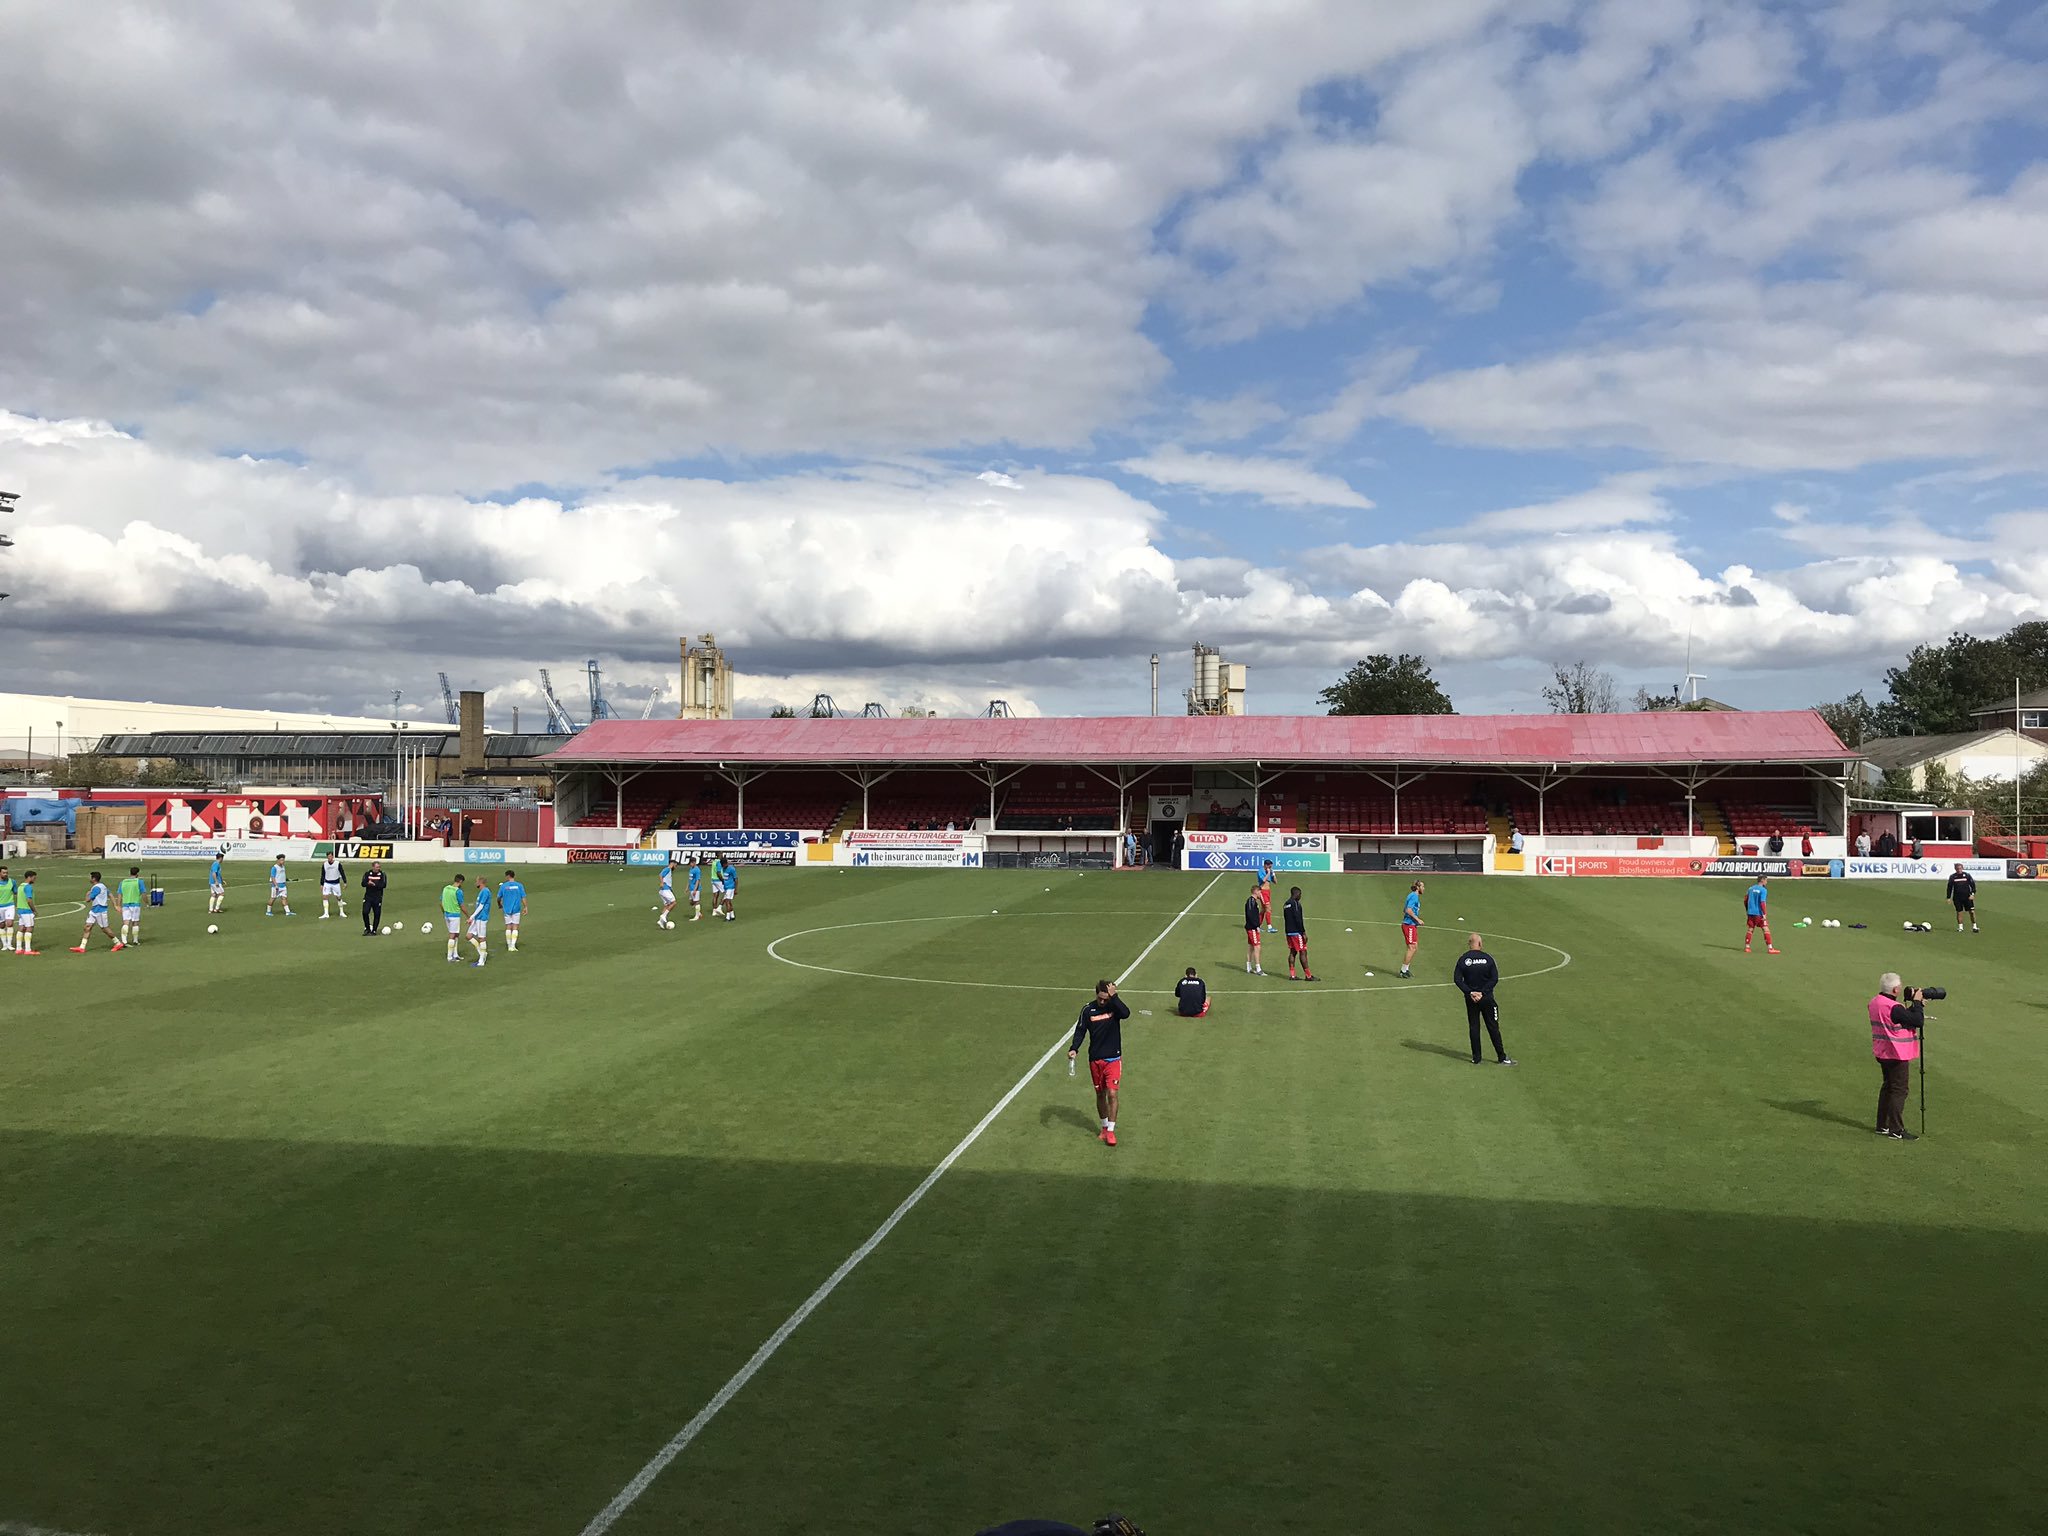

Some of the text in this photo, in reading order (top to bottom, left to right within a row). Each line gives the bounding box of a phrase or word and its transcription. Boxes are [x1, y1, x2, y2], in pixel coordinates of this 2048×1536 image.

[685, 832, 791, 840] GULLANDS
[111, 842, 137, 853] ARC
[1283, 837, 1320, 848] DPS
[568, 850, 608, 862] RELIANCE
[643, 853, 665, 861] JAKO
[750, 851, 780, 859] Products
[871, 852, 884, 861] the
[885, 852, 923, 861] insurance
[925, 853, 961, 863] manager
[1035, 855, 1060, 863] ESQUIRE
[1234, 855, 1312, 867] Kuflik.com
[1395, 858, 1424, 866] ESQUIRE
[1578, 861, 1608, 869] SPORTS
[1705, 861, 1787, 873] 2019/20 REPLICA SHIRTS
[1850, 862, 1927, 874] SYKES PUMPS
